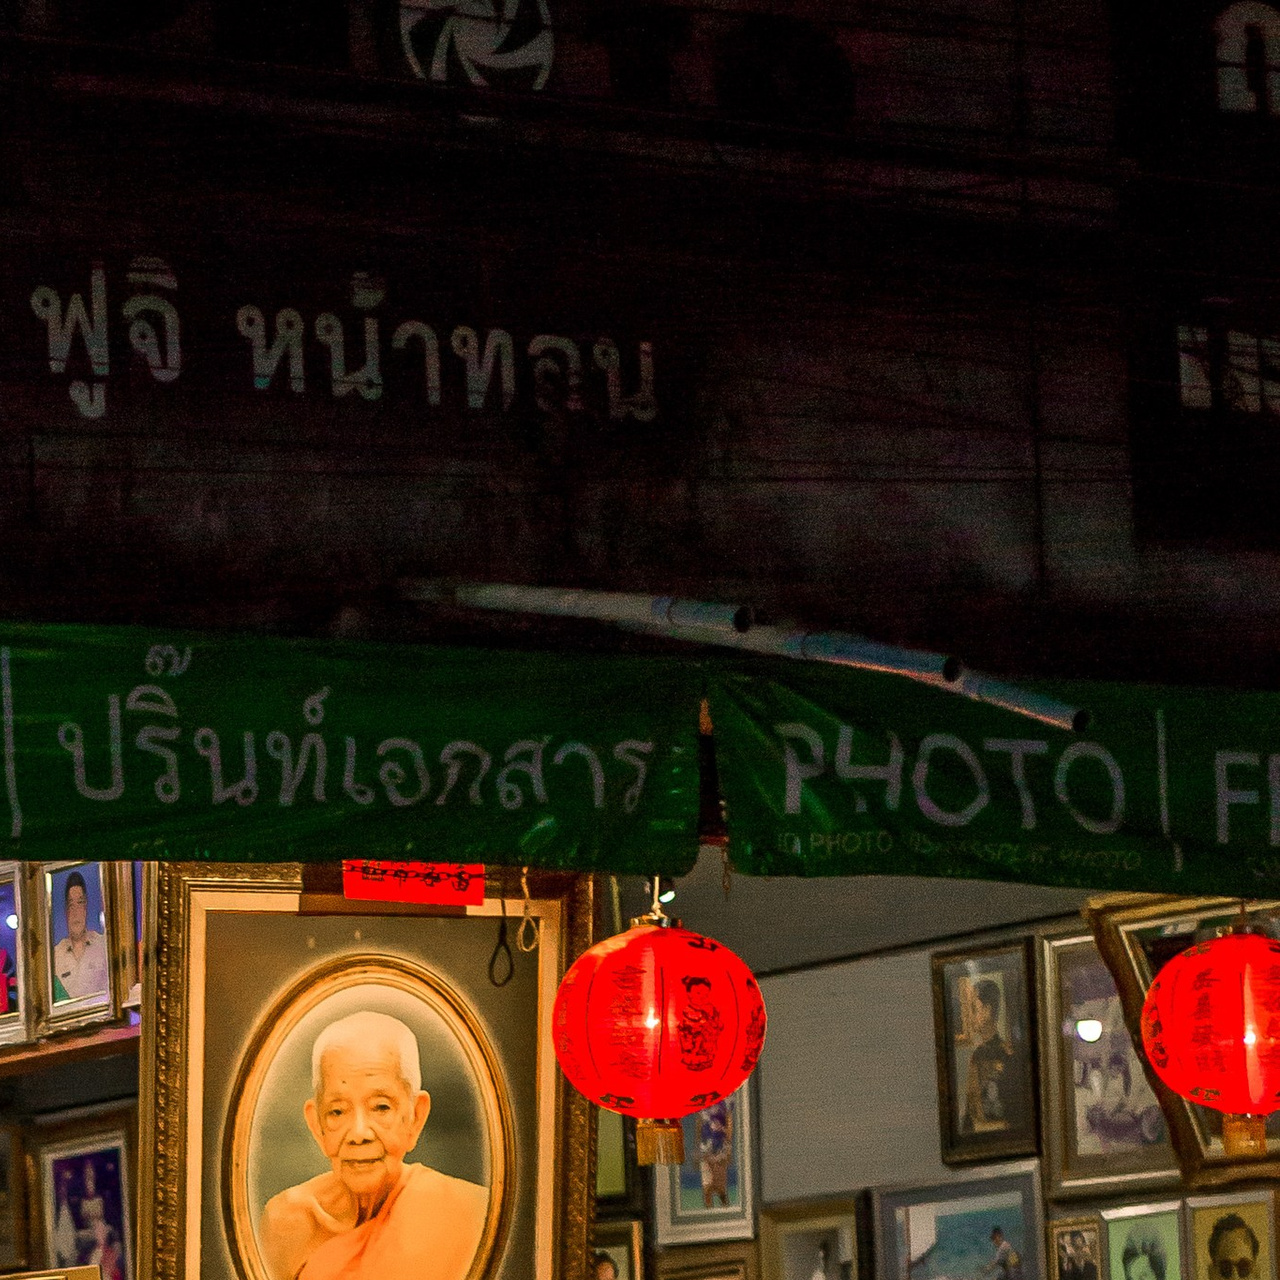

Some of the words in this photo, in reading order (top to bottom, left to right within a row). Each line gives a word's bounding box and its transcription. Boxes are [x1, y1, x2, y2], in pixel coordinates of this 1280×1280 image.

[57, 644, 656, 813] ปริ๊นท์เอกสาร
[776, 721, 1125, 834] PHOTO
[809, 831, 893, 858] PHOTO
